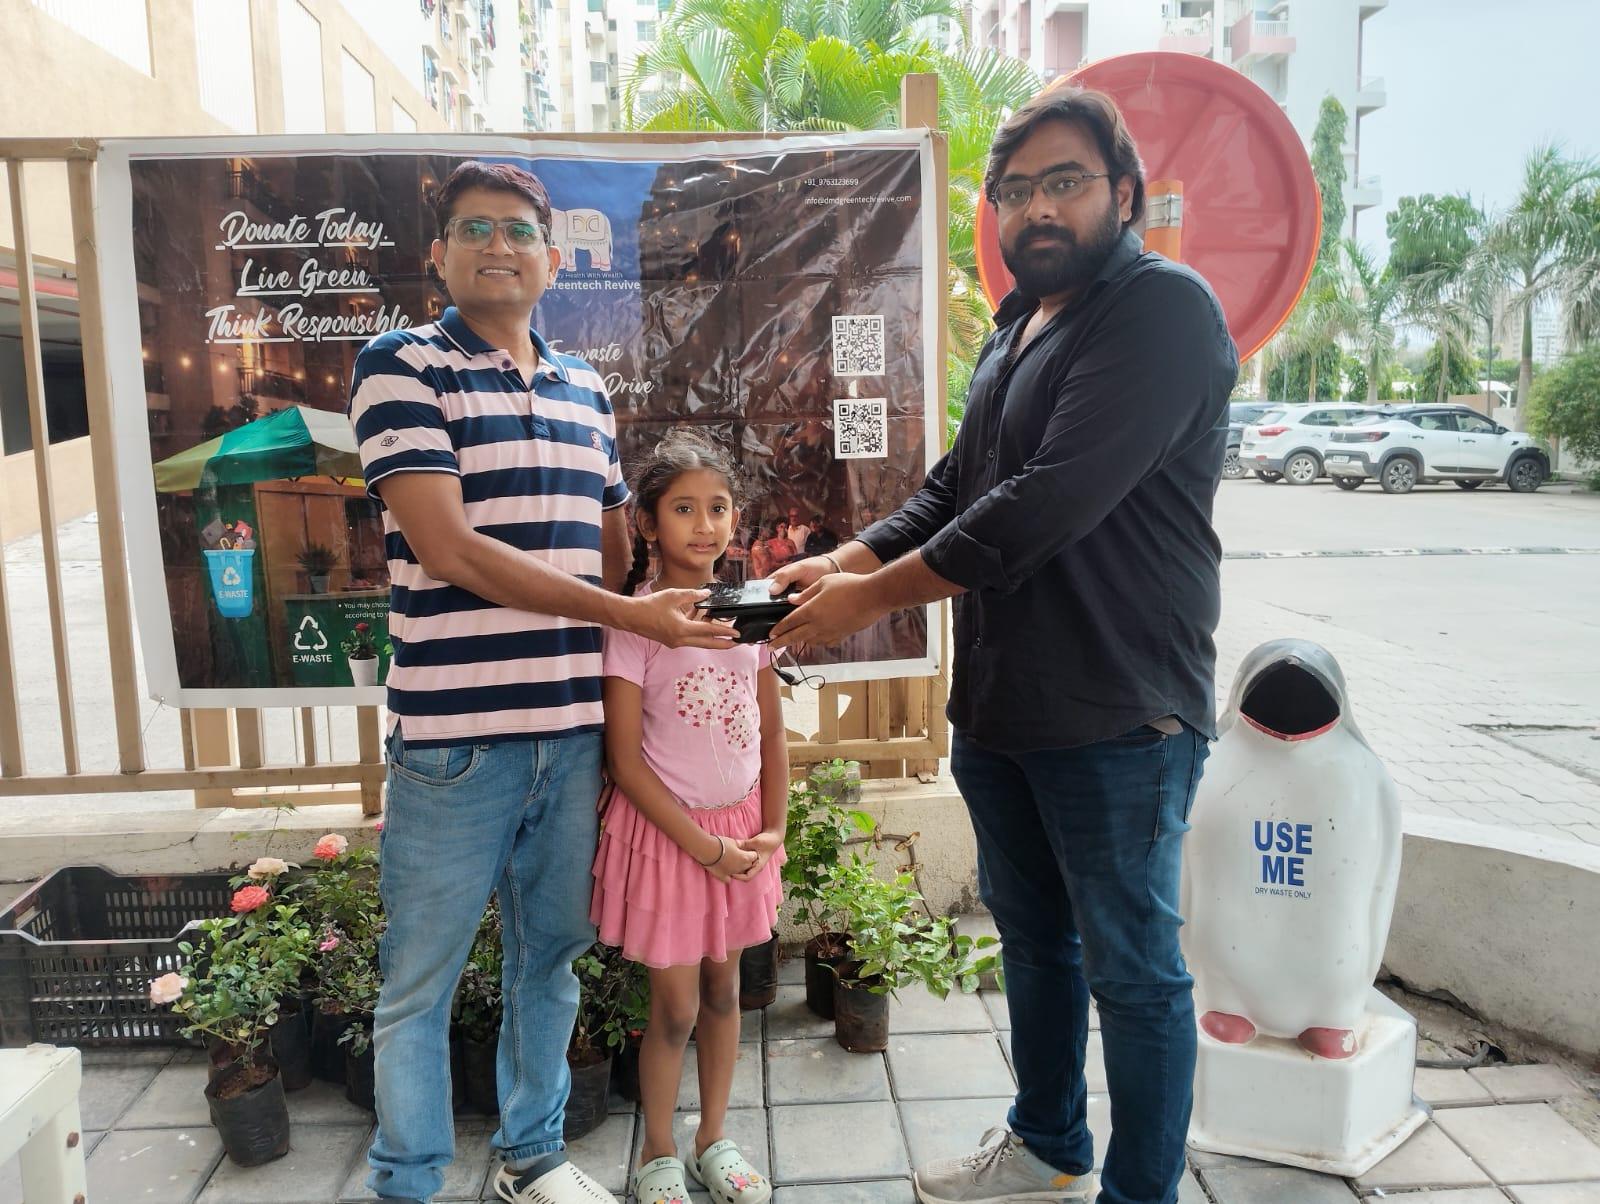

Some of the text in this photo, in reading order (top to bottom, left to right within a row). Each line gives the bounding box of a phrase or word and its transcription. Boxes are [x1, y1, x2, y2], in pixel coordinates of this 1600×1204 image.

[219, 207, 389, 250] Donate Today.
[240, 258, 374, 298] Live Green.
[587, 271, 601, 279] With
[604, 280, 641, 290] Revive
[205, 304, 272, 341] Think
[603, 372, 655, 398] Drive
[357, 602, 370, 610] may
[293, 654, 333, 663] E-WASTE
[1254, 820, 1313, 855] USE
[1262, 855, 1305, 886] ME
[1269, 888, 1293, 897] WASTE
[1294, 890, 1312, 899] ONLY
